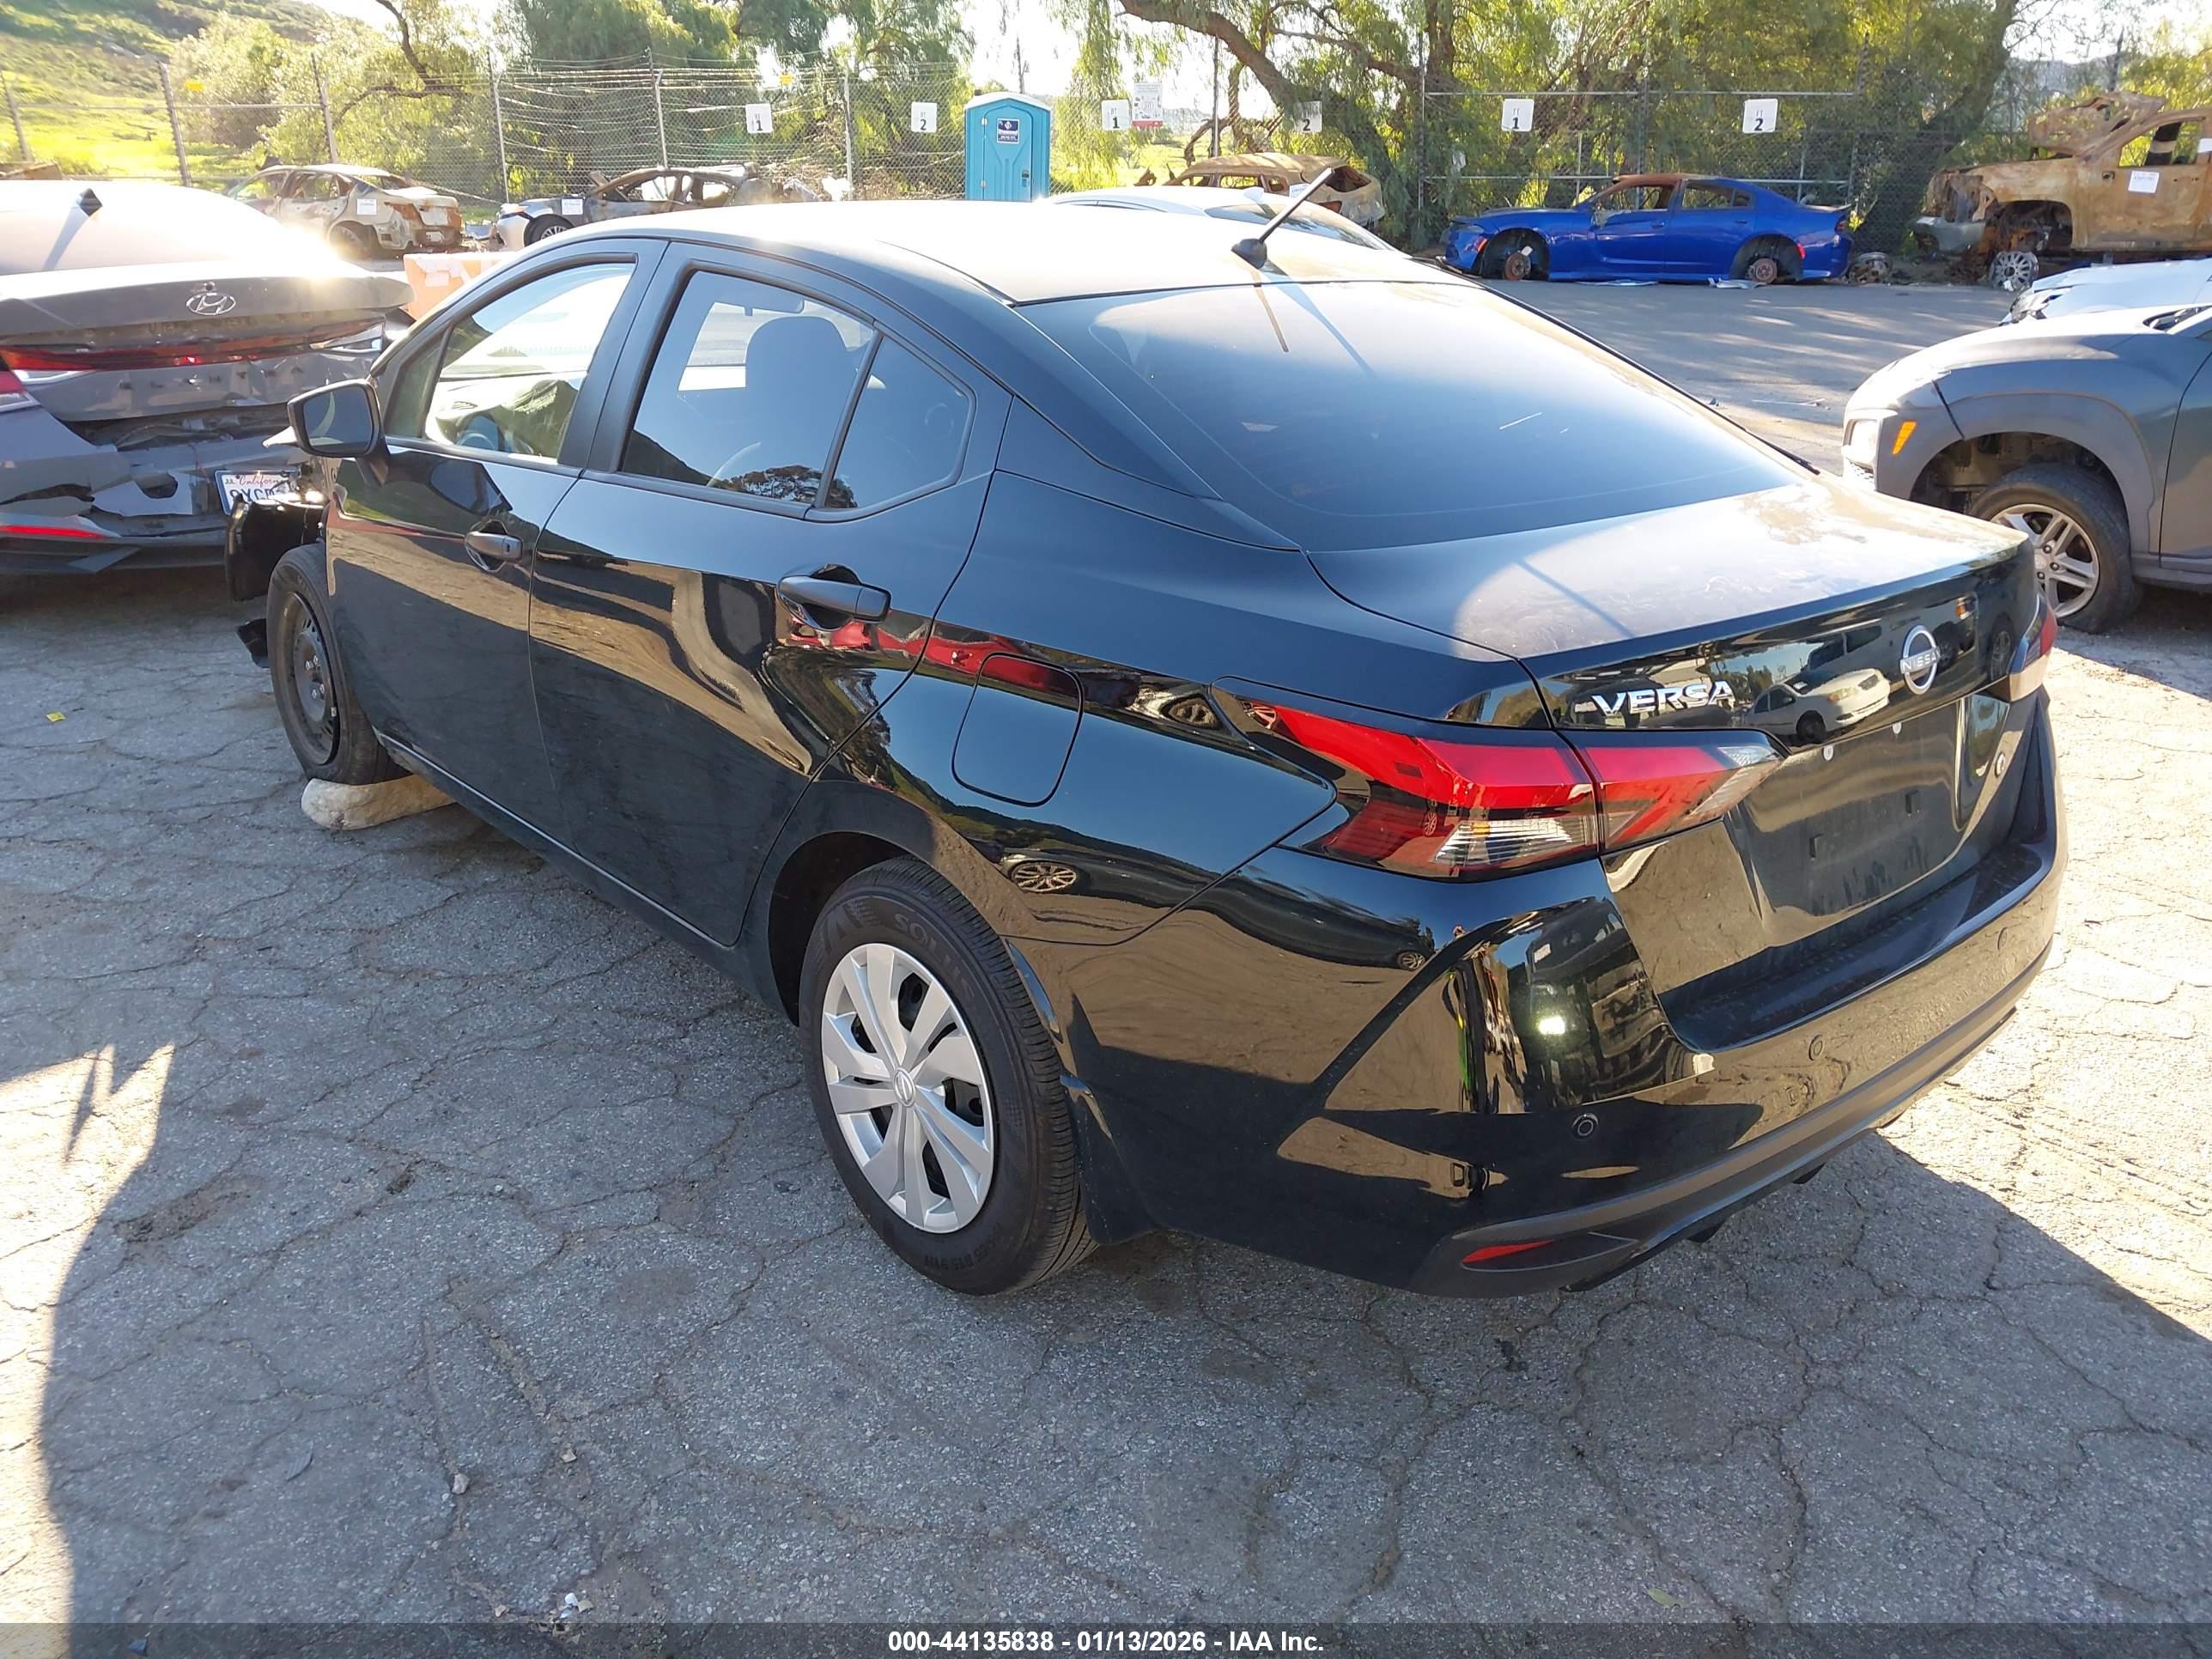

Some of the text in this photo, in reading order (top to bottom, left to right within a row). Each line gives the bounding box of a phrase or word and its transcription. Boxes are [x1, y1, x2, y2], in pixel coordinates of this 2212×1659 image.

[756, 119, 763, 131] 1
[920, 118, 927, 131] 2
[1113, 117, 1120, 129] 1
[1303, 118, 1311, 131] 2
[1512, 117, 1520, 130] 1
[1754, 118, 1764, 131] 2
[1592, 680, 1736, 717] VERSA
